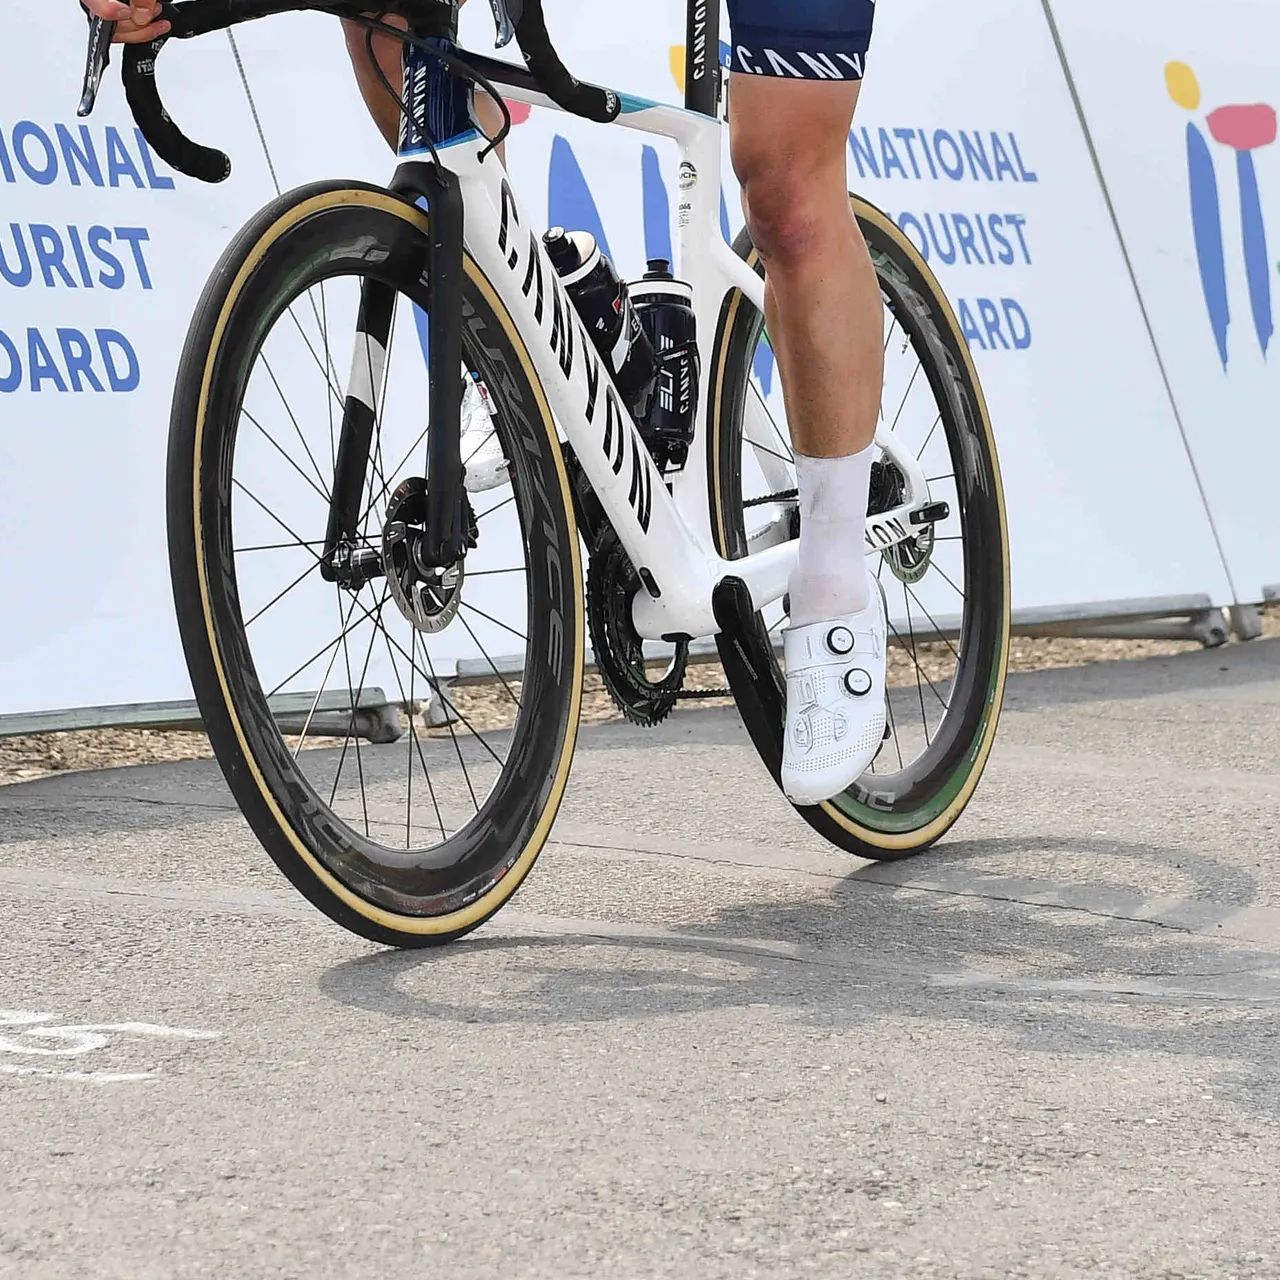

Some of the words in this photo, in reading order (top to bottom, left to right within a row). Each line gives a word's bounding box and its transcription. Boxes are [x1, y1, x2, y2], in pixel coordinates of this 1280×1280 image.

[848, 126, 1038, 184] NATIONAL
[885, 212, 1034, 267] OURIST
[962, 297, 1034, 351] ARD
[499, 179, 653, 535] CANYON
[462, 293, 563, 688] URA-ACE
